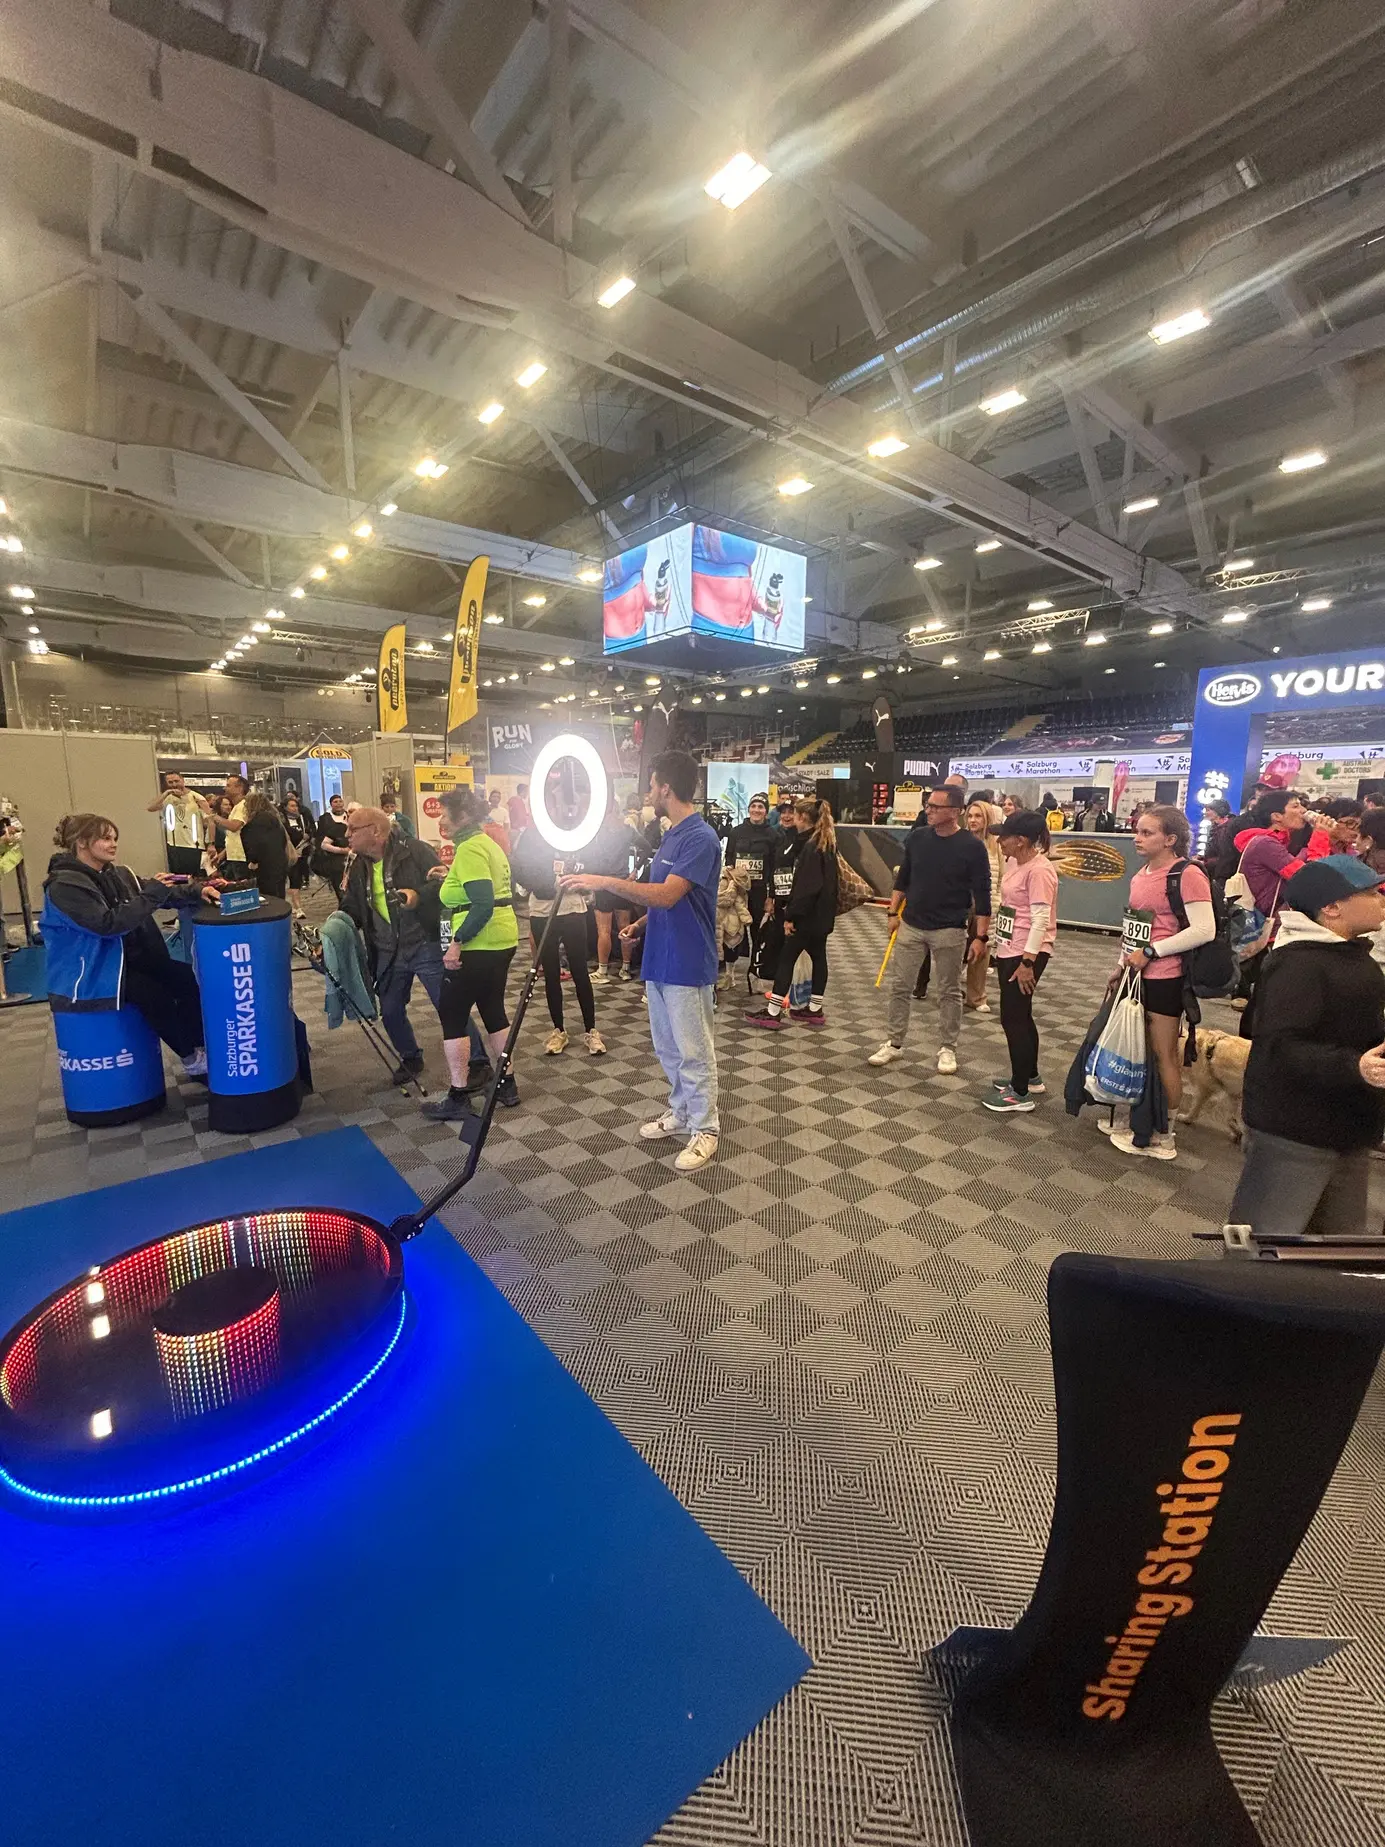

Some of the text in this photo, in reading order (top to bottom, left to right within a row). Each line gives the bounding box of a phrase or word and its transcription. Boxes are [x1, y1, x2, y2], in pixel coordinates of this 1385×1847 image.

[1270, 663, 1385, 698] YOUR
[492, 724, 532, 748] RUN
[903, 760, 931, 776] PUMA
[1178, 755, 1191, 763] Sa
[1128, 922, 1150, 940] 890
[233, 964, 259, 1077] SPARKASSE
[226, 1018, 238, 1077] Salzburger
[59, 1055, 114, 1072] RKASSE
[1082, 1413, 1242, 1721] Sharing Station
